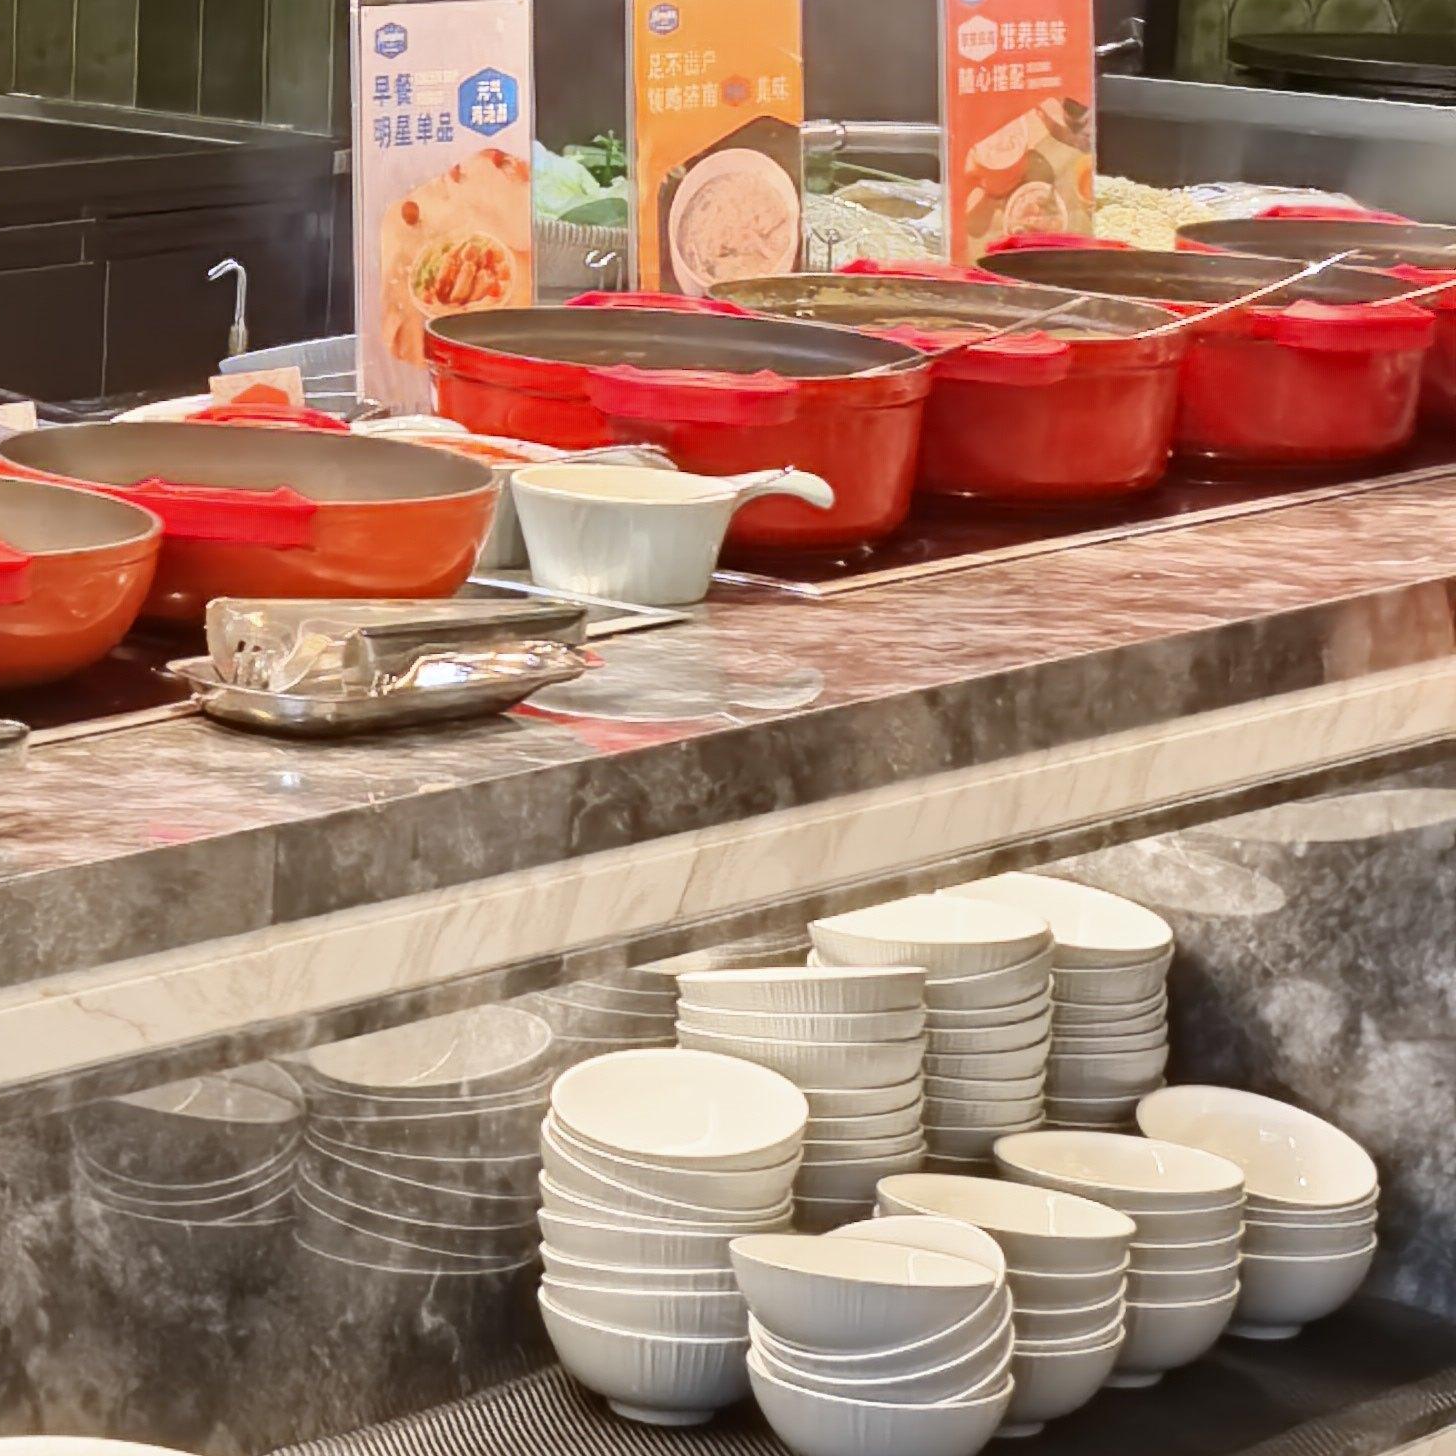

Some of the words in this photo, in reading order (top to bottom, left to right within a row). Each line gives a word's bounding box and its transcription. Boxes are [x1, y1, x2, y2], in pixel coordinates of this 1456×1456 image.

[373, 73, 413, 107] 早餐
[373, 111, 454, 149] 明星单品
